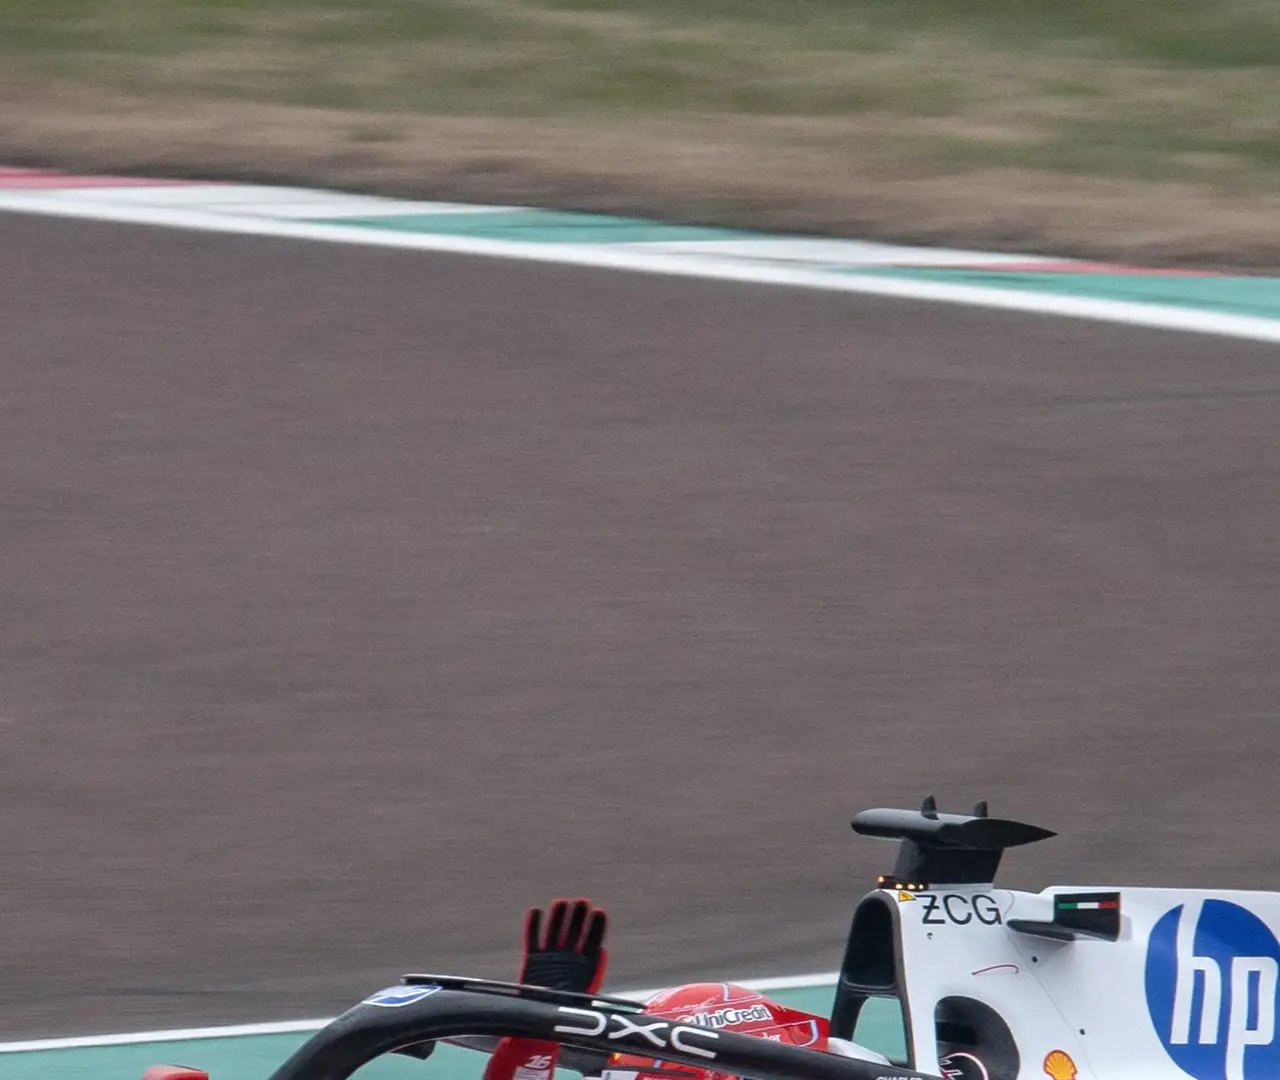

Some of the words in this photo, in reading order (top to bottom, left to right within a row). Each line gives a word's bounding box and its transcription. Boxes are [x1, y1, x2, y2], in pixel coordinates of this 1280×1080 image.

[920, 893, 1003, 926] ZCG
[693, 1004, 774, 1028] UniCredit
[554, 1005, 720, 1059] DXC
[524, 1054, 552, 1069] 16
